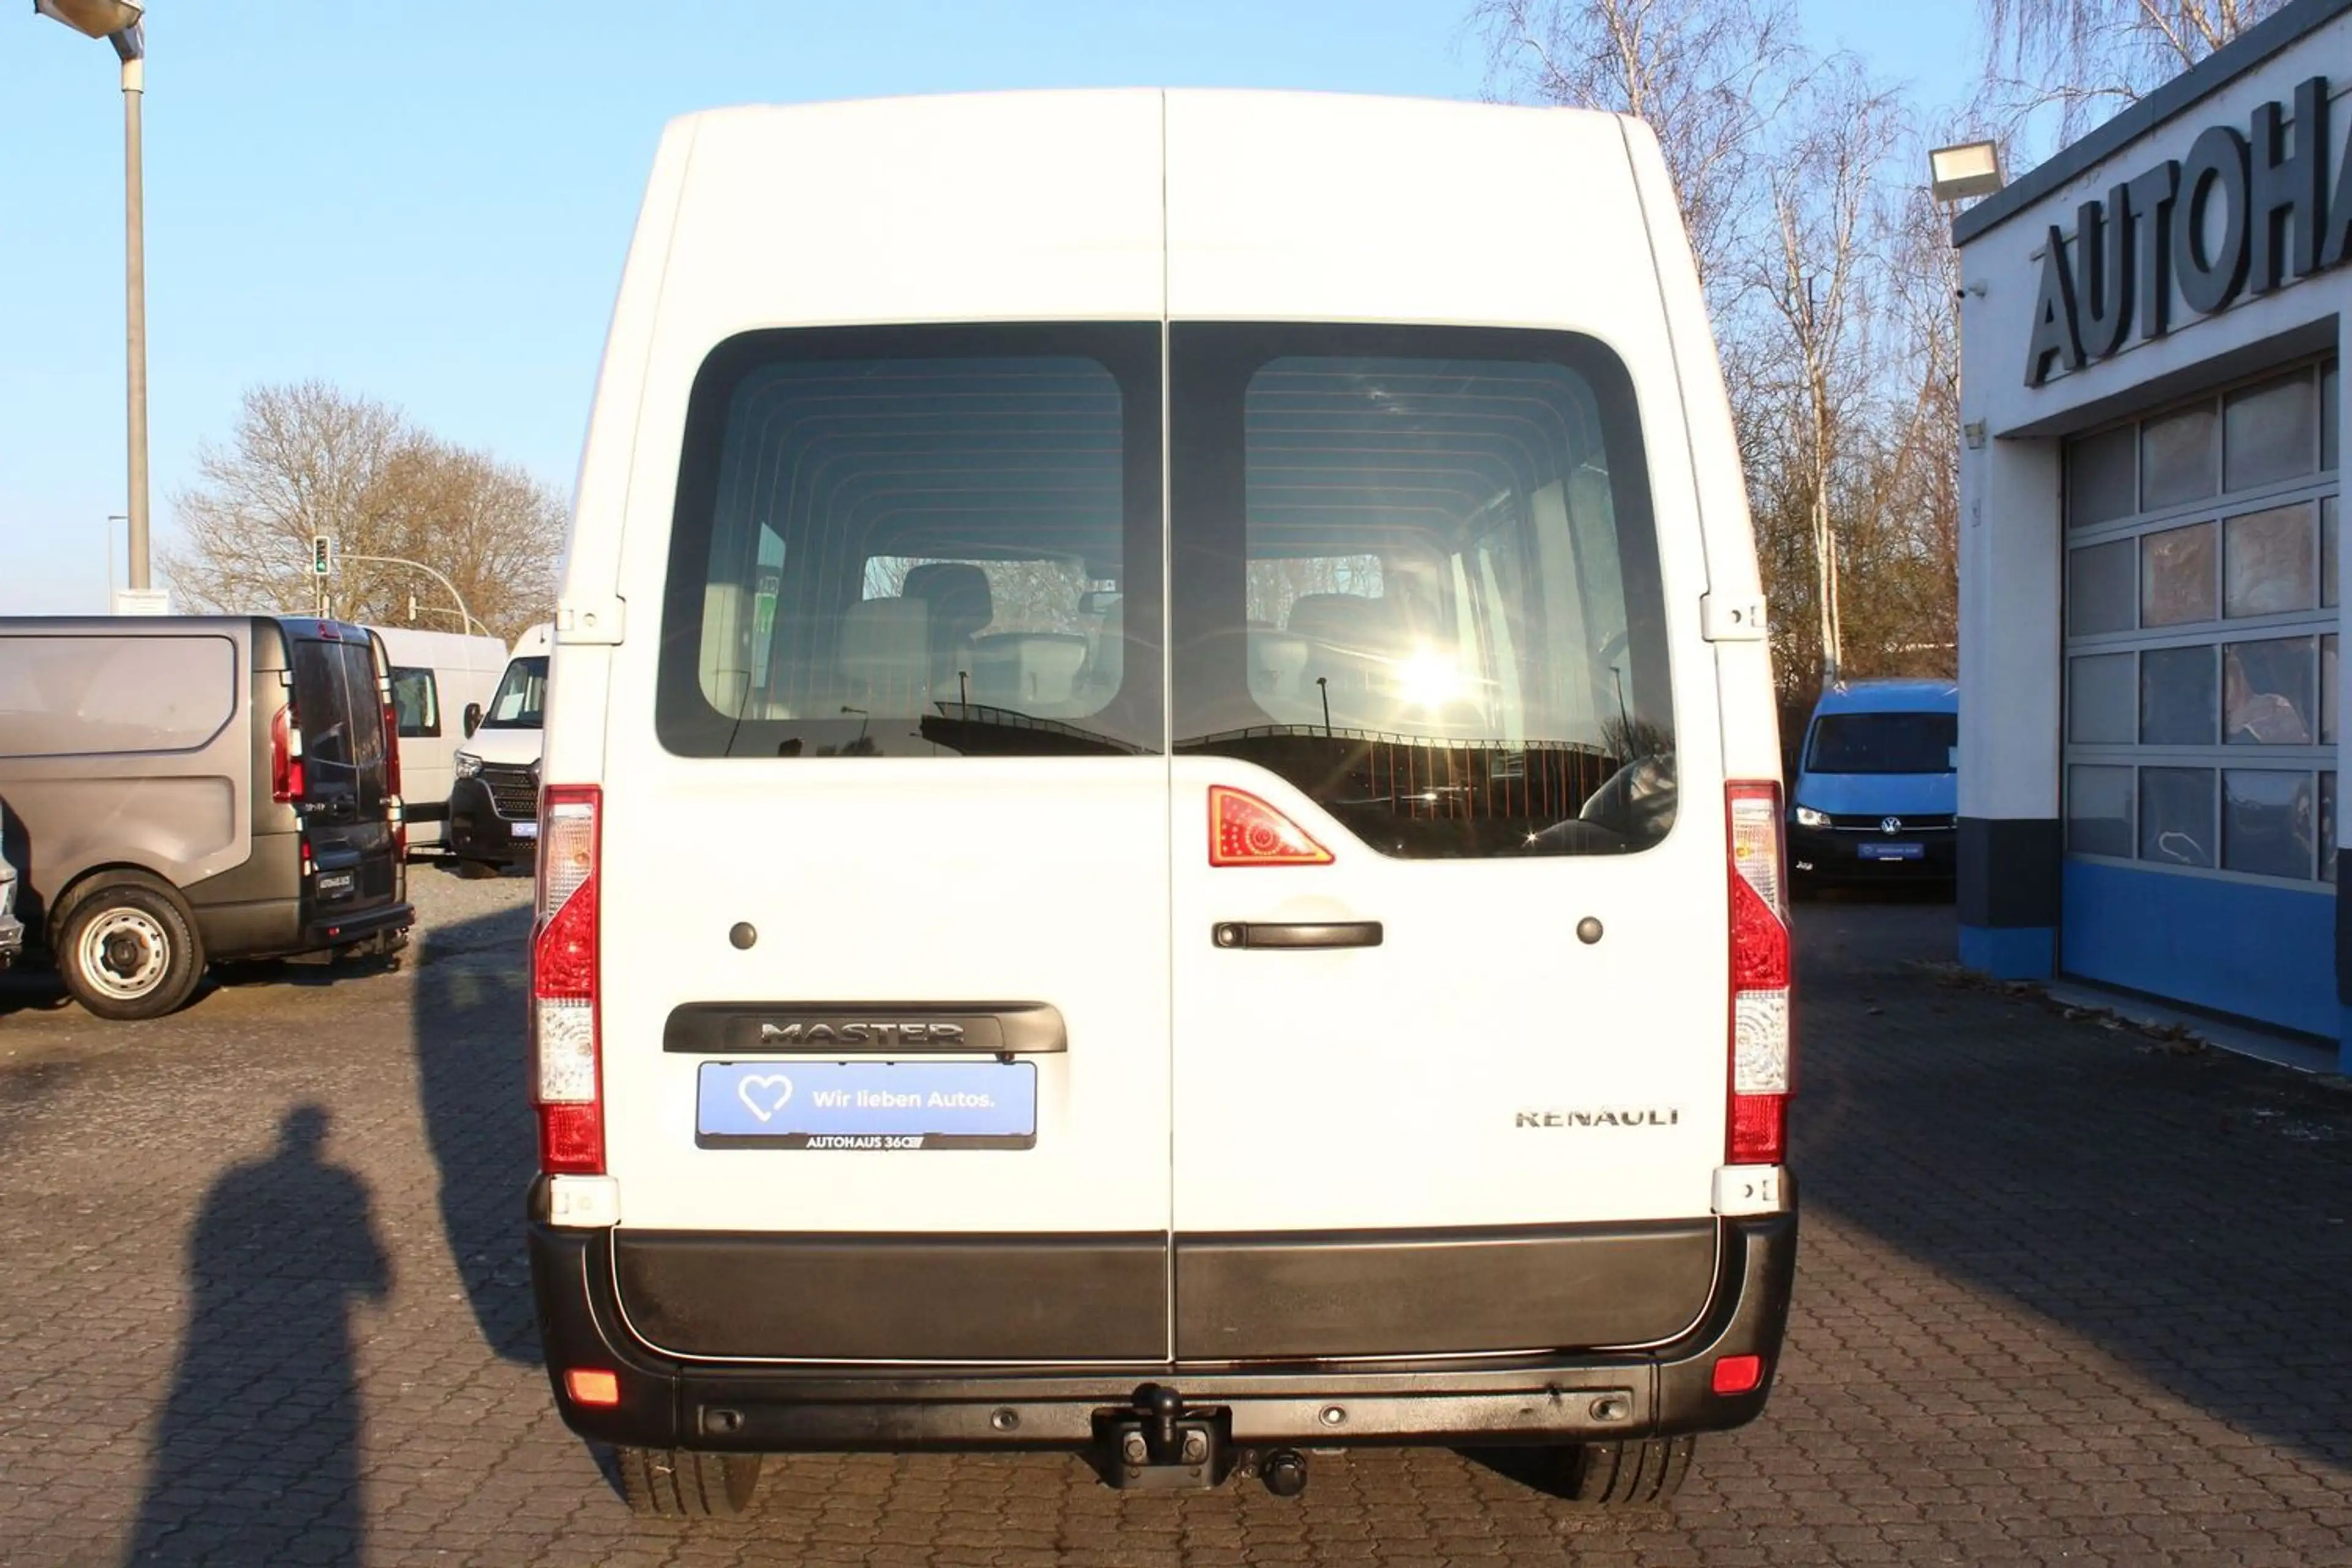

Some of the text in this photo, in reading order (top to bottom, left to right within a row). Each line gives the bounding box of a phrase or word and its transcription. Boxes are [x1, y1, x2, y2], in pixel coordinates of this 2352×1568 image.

[761, 1023, 964, 1044] MASTER
[812, 1090, 995, 1108] Wir lieben Autos.
[806, 1136, 882, 1148] AUTOHAUS
